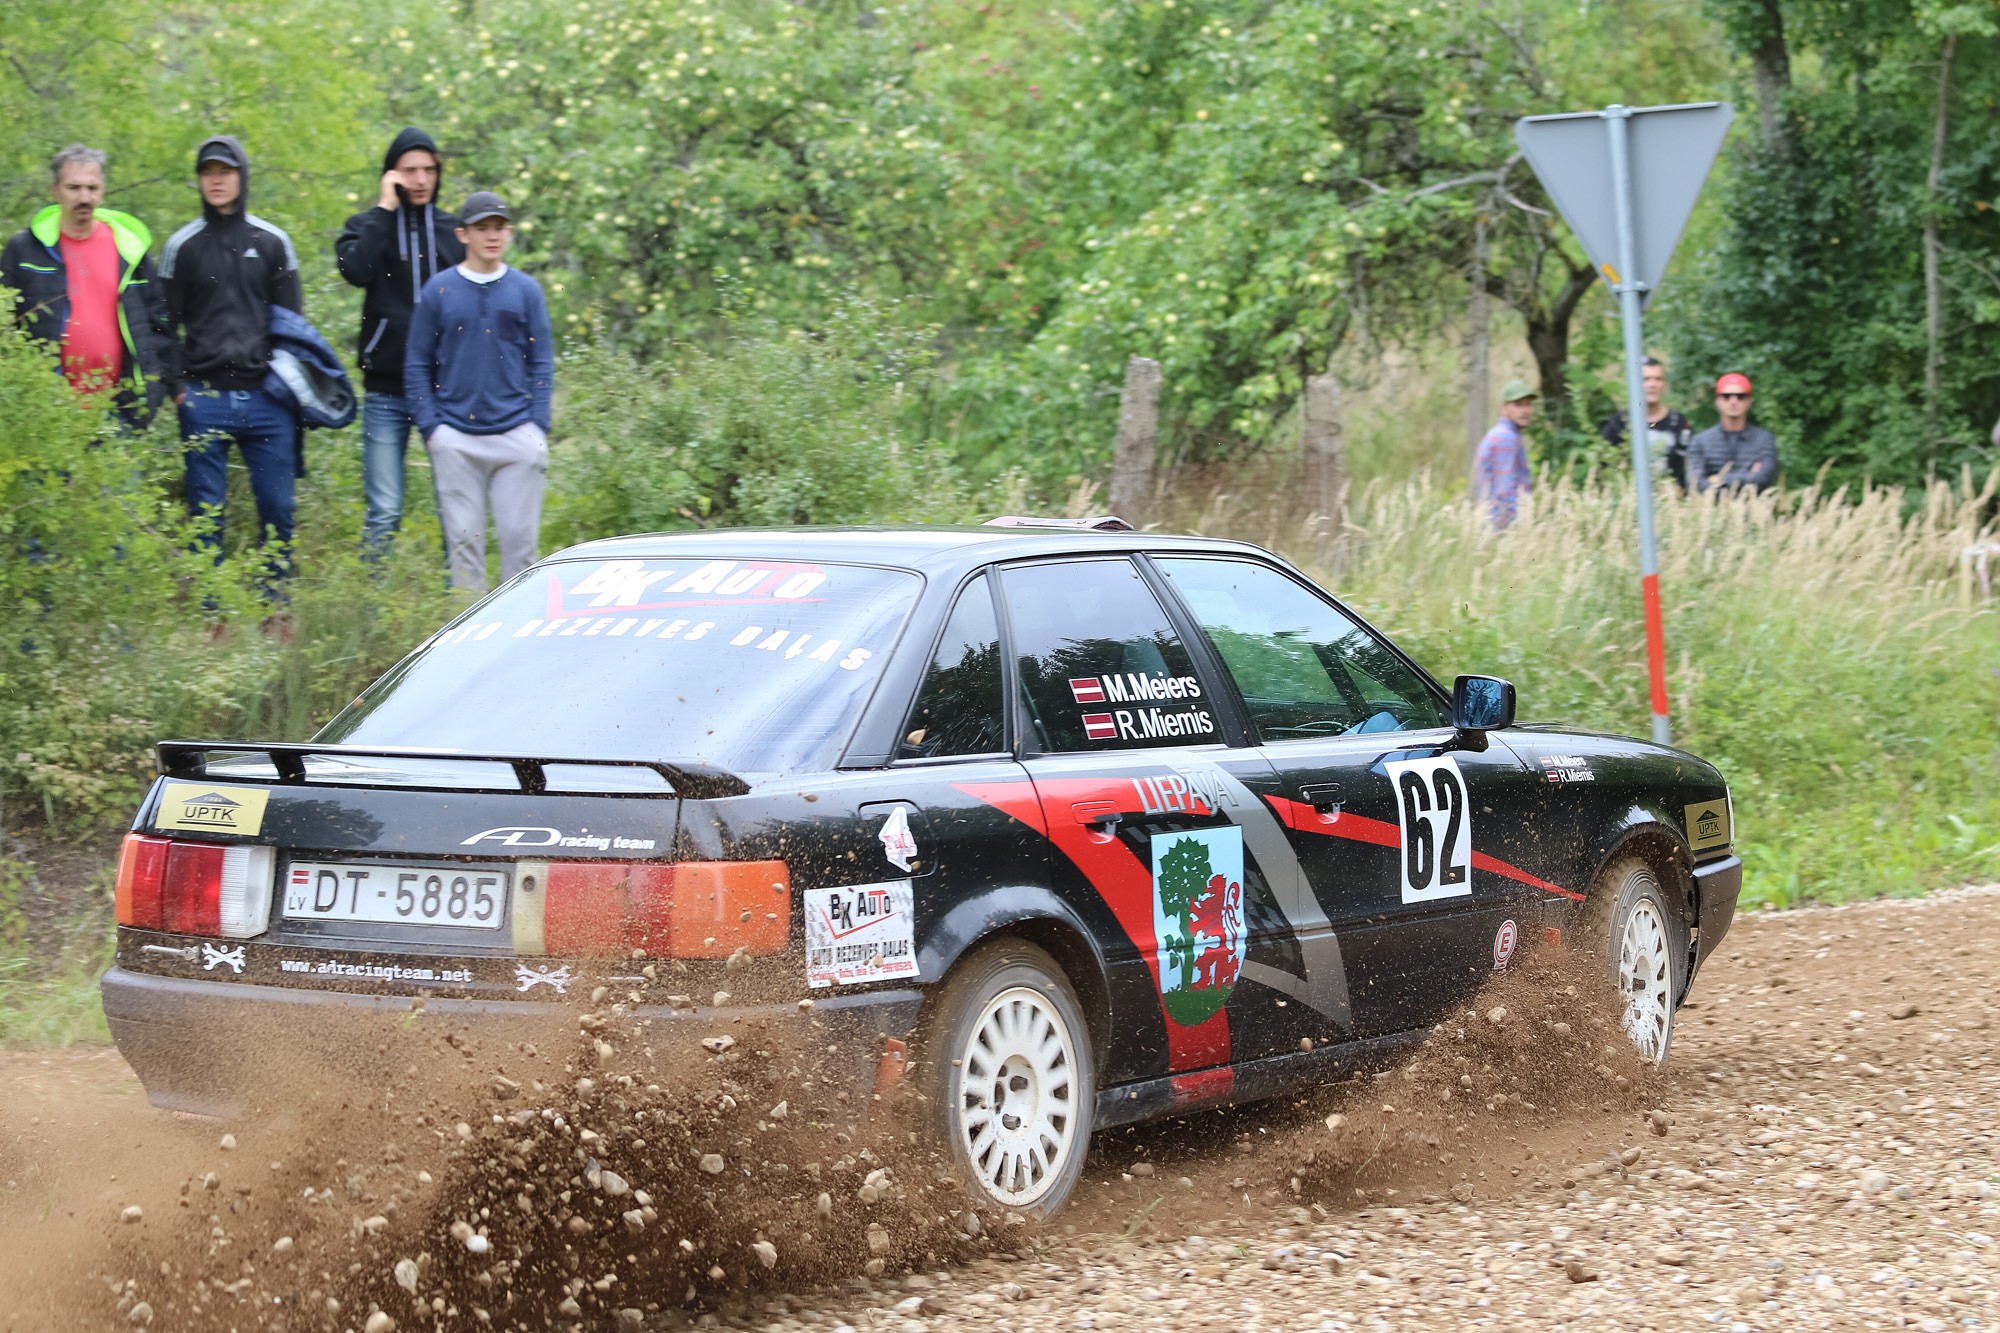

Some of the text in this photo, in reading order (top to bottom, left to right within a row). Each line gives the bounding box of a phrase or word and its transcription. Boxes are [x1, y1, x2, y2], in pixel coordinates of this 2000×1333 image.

[568, 560, 828, 607] BK AUTO
[431, 621, 504, 648] UTO
[511, 617, 716, 641] REZERVES
[1101, 671, 1201, 703] M.Meiers
[1115, 704, 1214, 740] R.Miemis
[184, 805, 235, 821] UPTK
[1399, 767, 1466, 891] 62
[1698, 820, 1720, 835] UPTK
[559, 834, 609, 850] racing
[613, 835, 655, 849] team
[288, 896, 307, 911] LV
[281, 958, 472, 983] www.adracingteam.net
